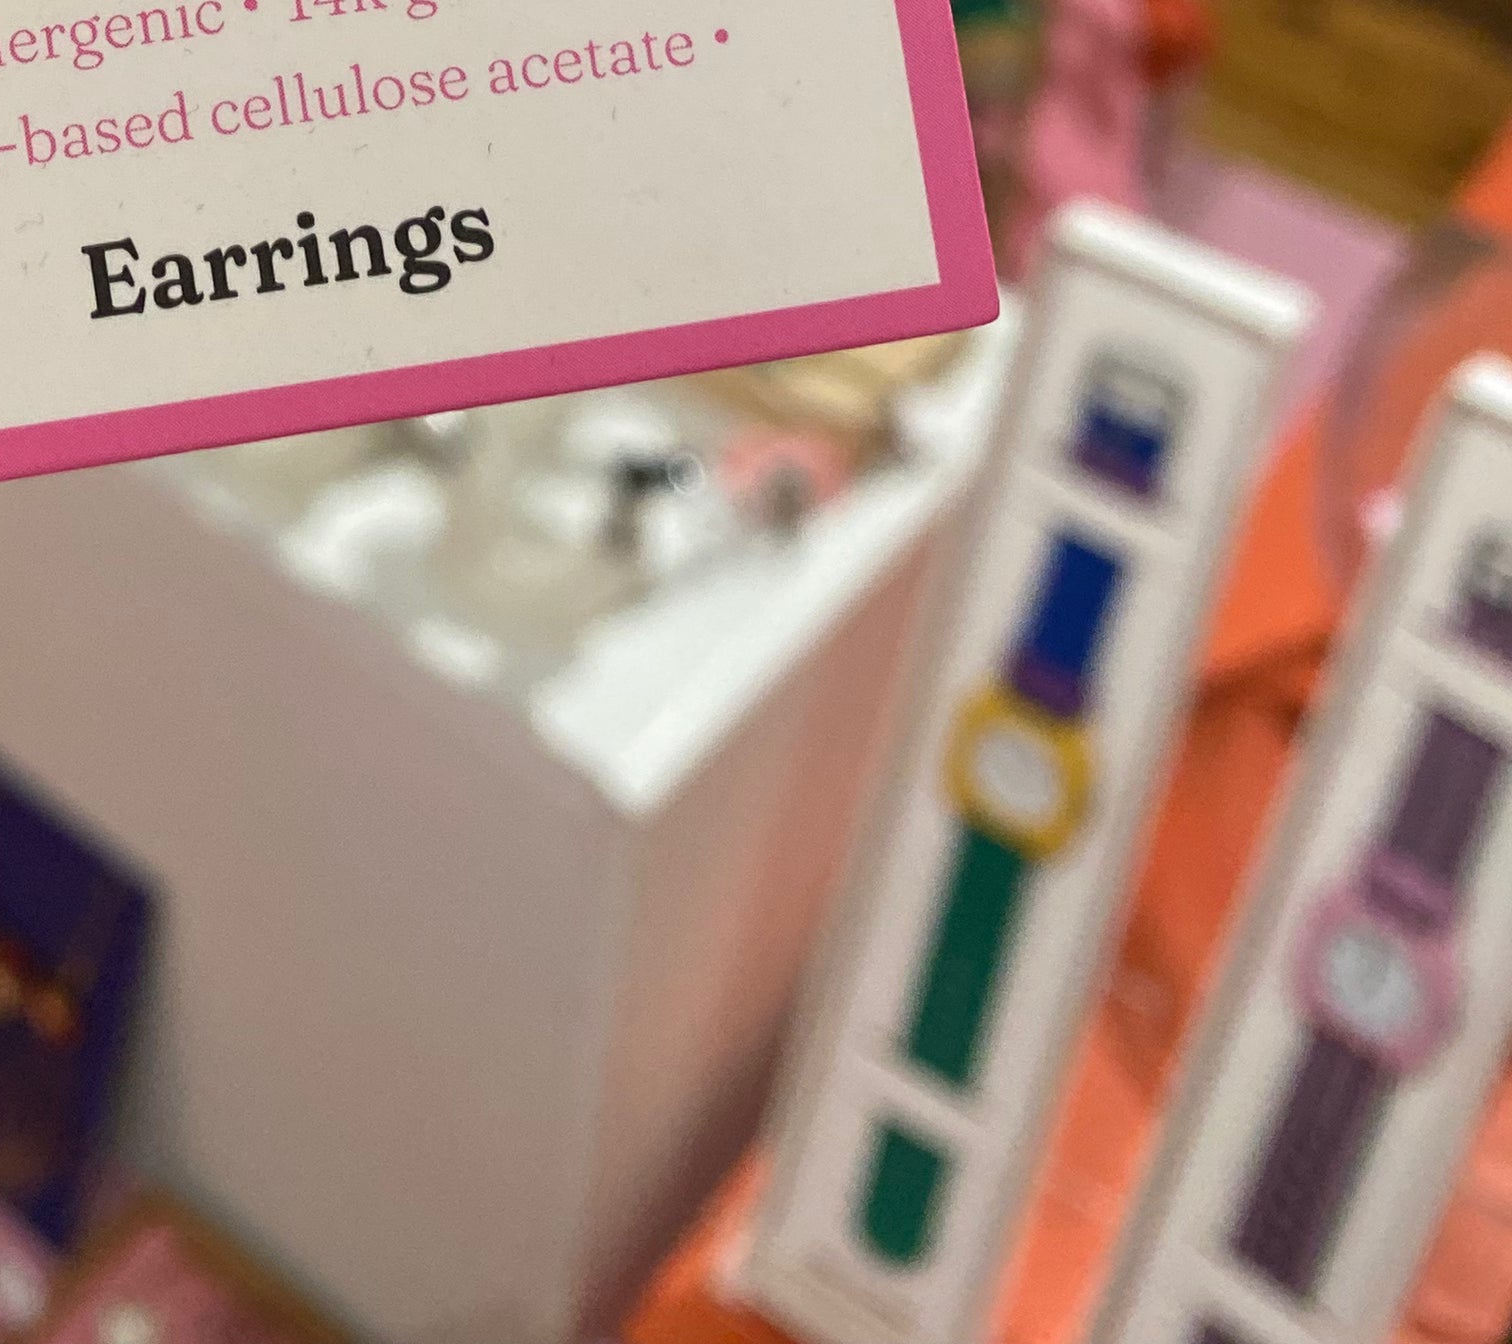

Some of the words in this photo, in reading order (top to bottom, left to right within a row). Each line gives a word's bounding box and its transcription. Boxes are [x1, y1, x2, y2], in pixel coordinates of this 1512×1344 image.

[209, 63, 470, 137] cellulose
[487, 30, 697, 96] acetate
[80, 197, 496, 320] Earrings
